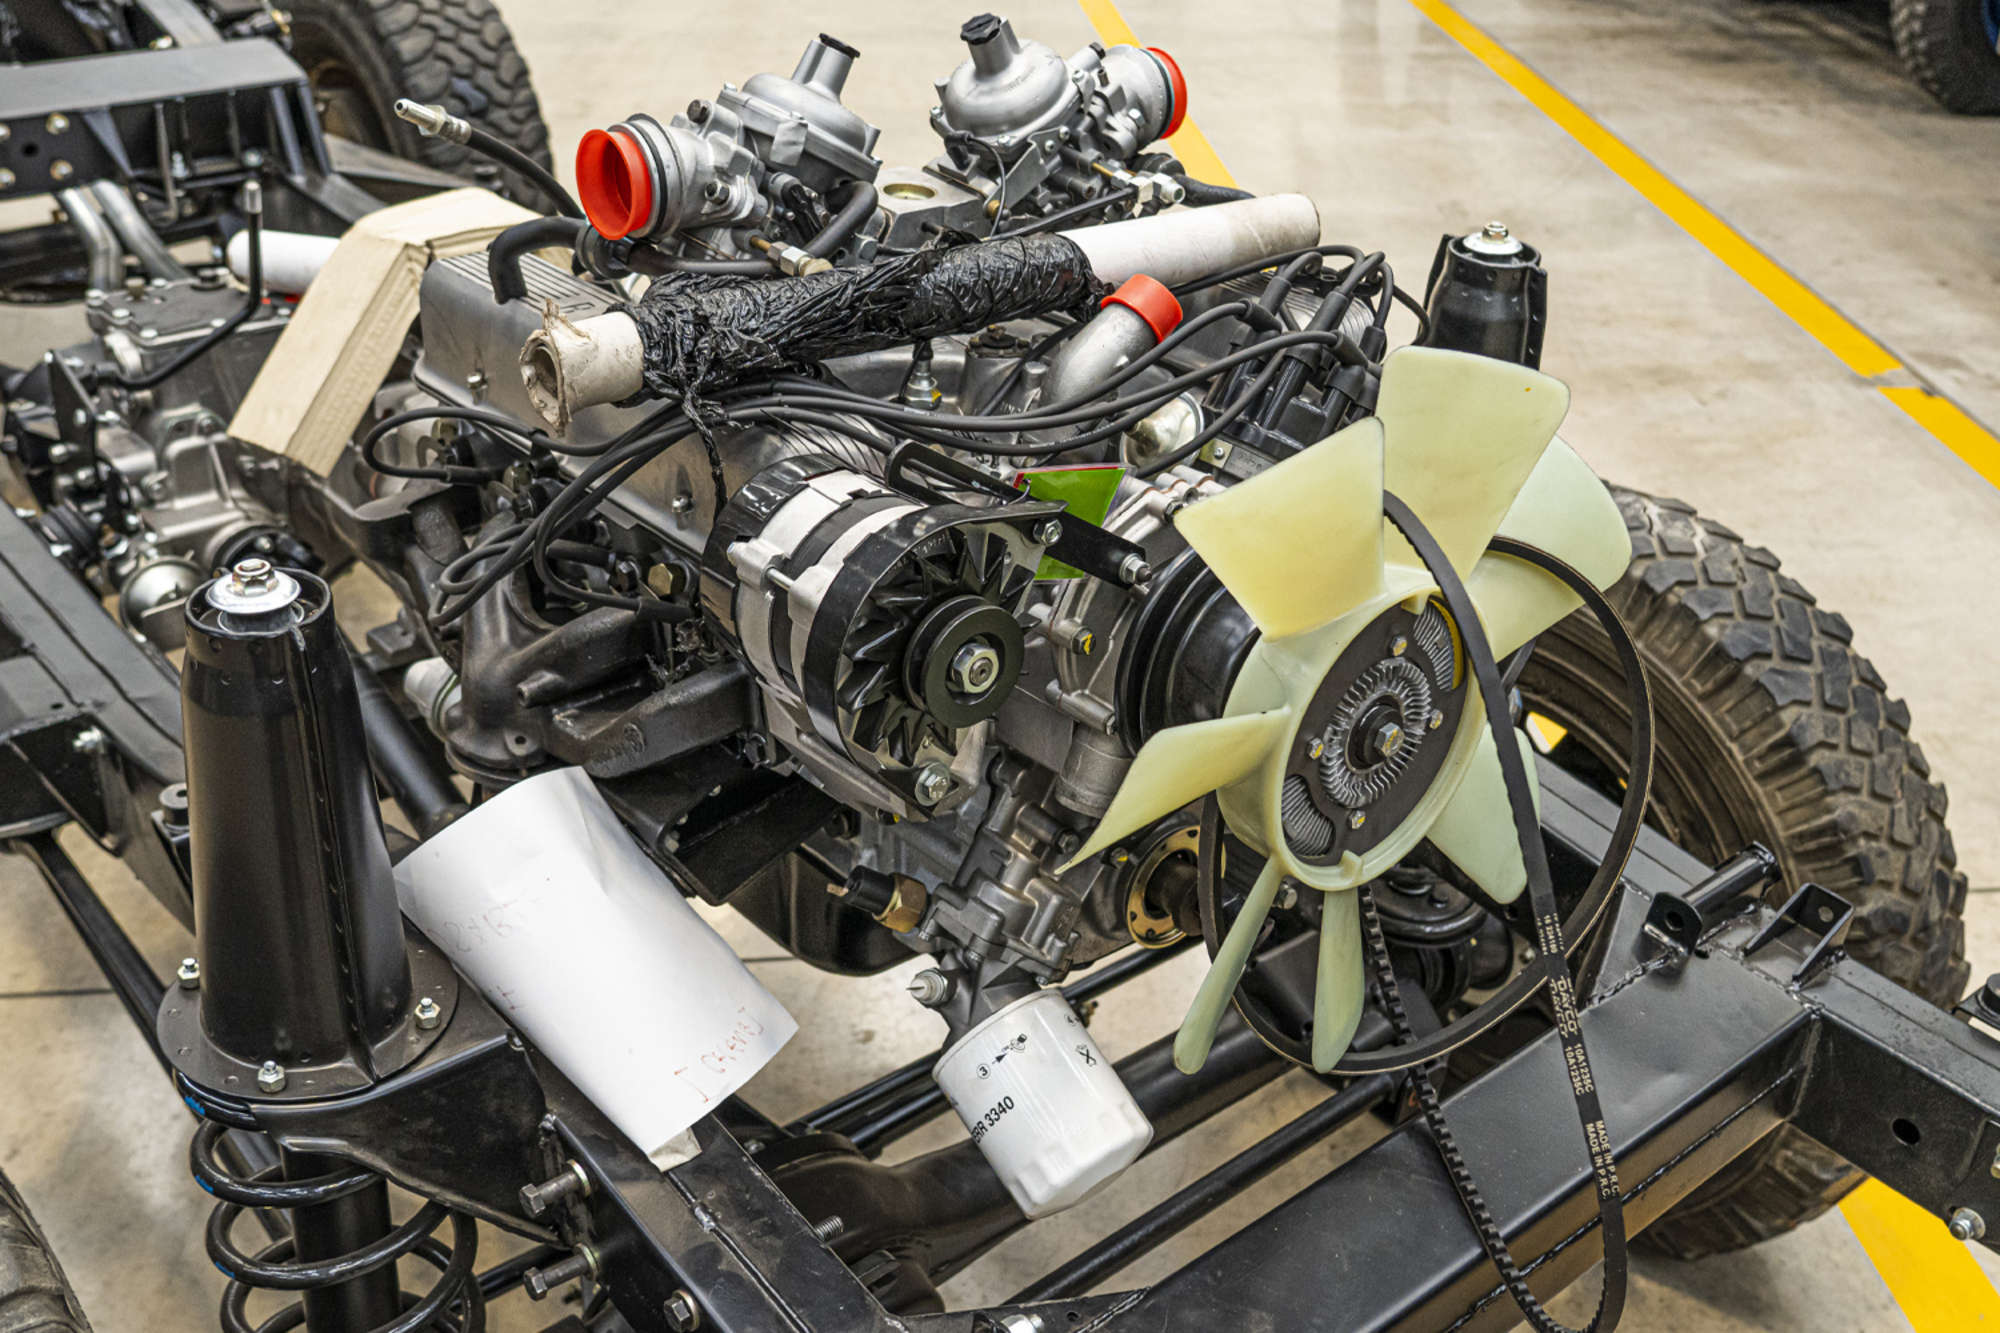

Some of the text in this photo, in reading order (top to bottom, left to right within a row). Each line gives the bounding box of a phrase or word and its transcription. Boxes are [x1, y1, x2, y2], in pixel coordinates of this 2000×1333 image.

[1557, 976, 1578, 1035] DAYCO
[978, 1065, 989, 1077] 3
[984, 1096, 1014, 1127] 3340
[1586, 1123, 1611, 1200] MADE IN P.R.C.
[1595, 1120, 1620, 1197] MADE IN P.R.C.
